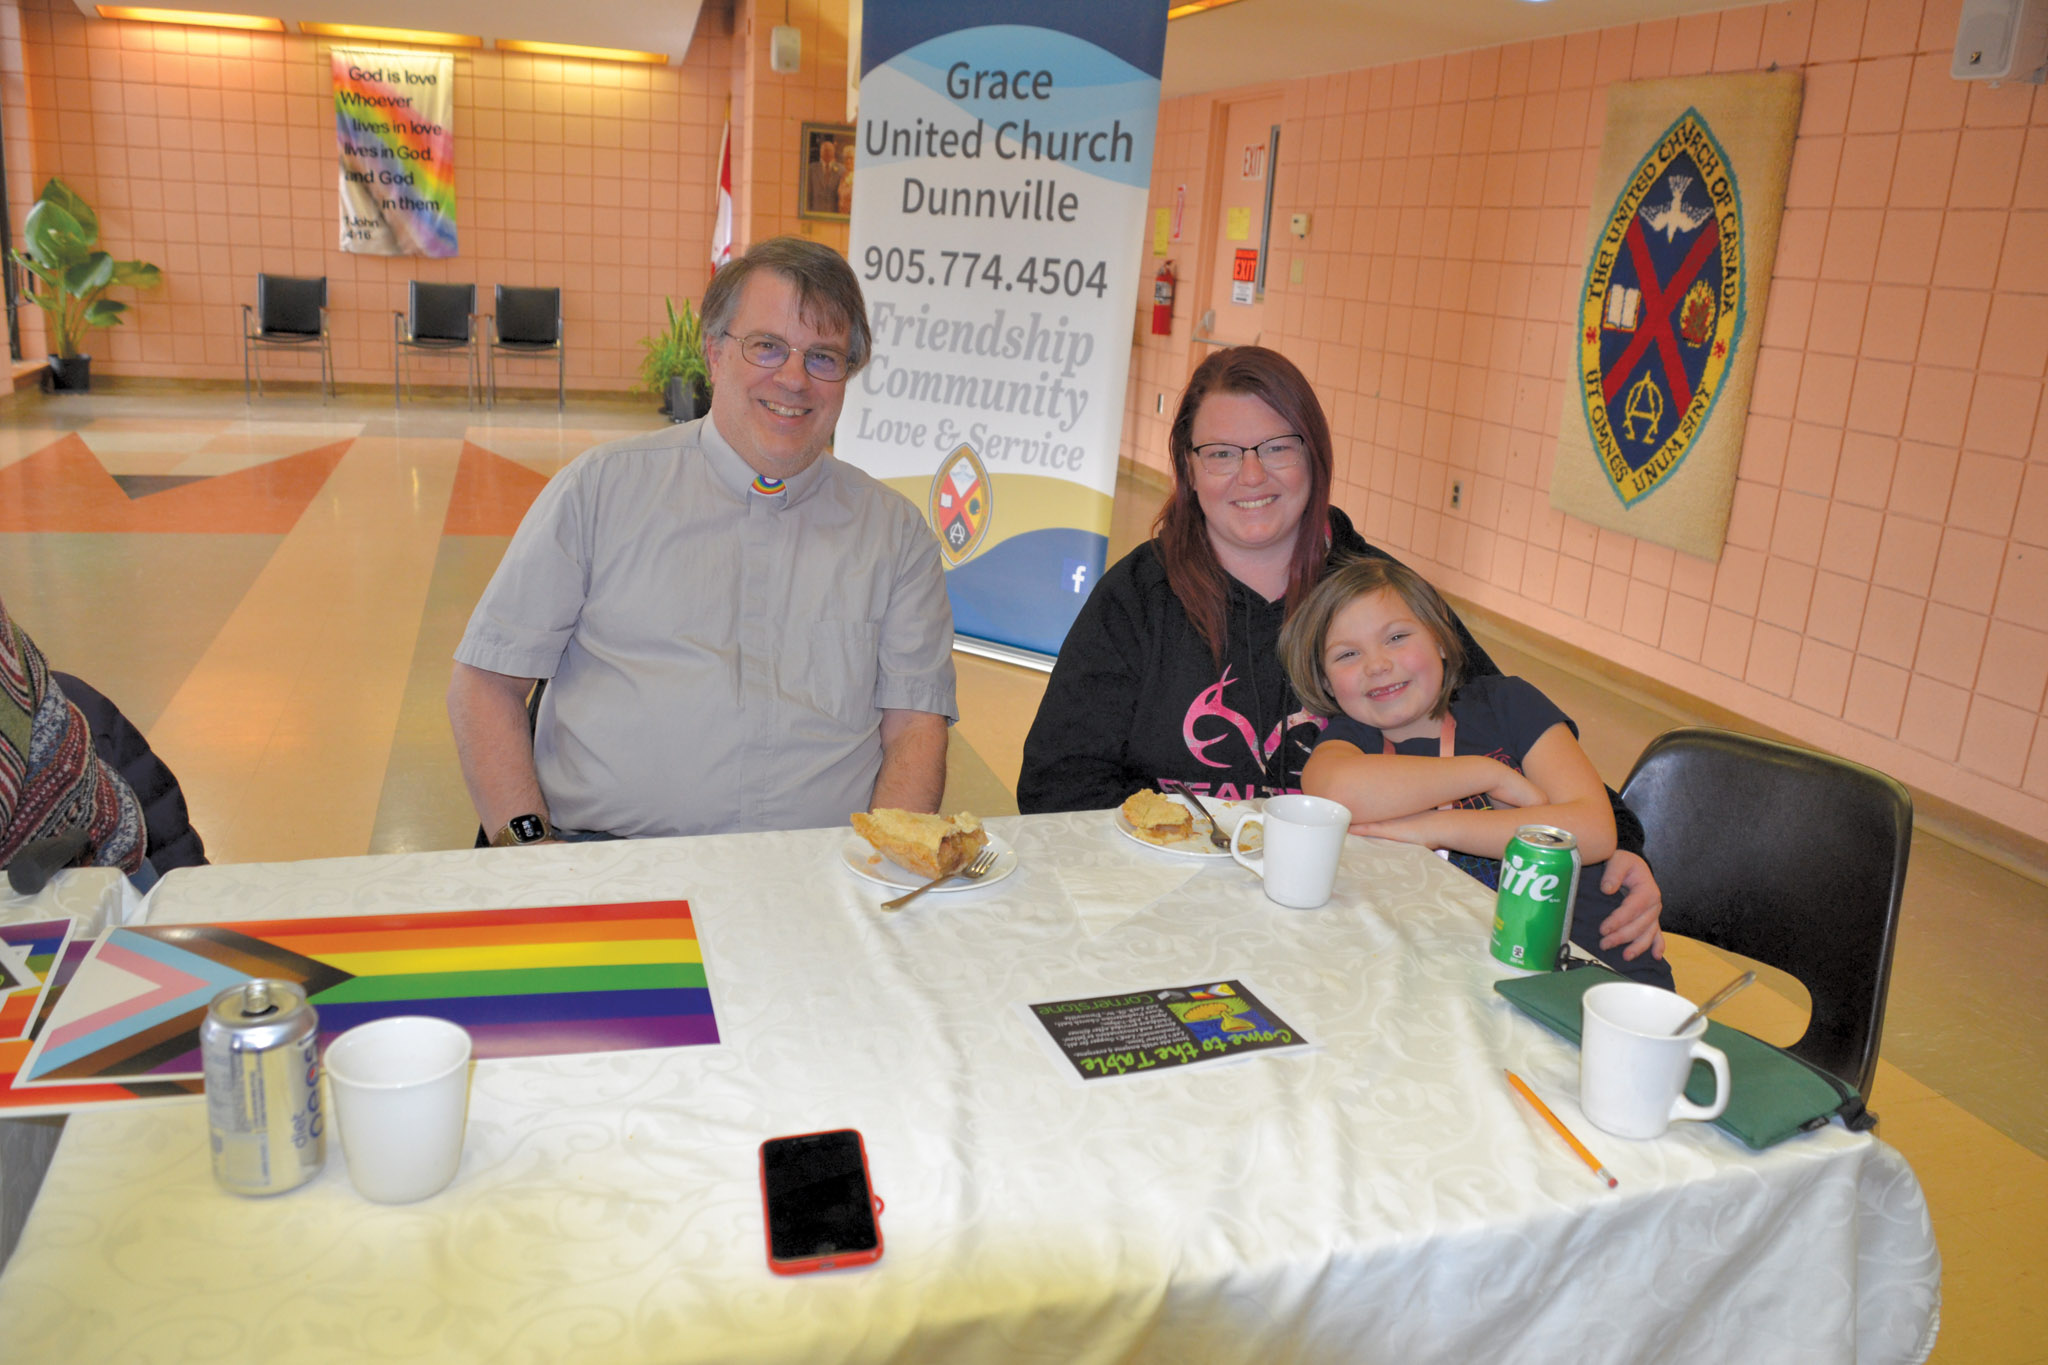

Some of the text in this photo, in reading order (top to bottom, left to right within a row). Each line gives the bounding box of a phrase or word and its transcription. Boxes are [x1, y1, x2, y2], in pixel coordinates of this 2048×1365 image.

[349, 66, 437, 85] God is love
[946, 61, 1053, 100] Grace
[340, 91, 413, 108] Whoever
[352, 117, 442, 136] lives in love
[865, 117, 1133, 163] United Church
[344, 143, 434, 161] lives in God.
[1243, 144, 1265, 176] EXIT
[345, 170, 414, 186] and God
[1711, 177, 1733, 207] OF
[382, 197, 440, 212] in them
[902, 177, 1079, 222] Dunnville
[1606, 163, 1656, 243] UNITED
[350, 215, 379, 228] John
[863, 246, 1108, 299] 905.774.4504
[1233, 259, 1256, 281] EXIT
[1589, 250, 1613, 302] THE
[1720, 211, 1737, 317] CANADA
[870, 301, 1095, 378] Friendship
[861, 354, 1089, 433] Community
[856, 407, 1085, 472] Love & Service
[1585, 368, 1712, 493] UT OMNES UNUM SINT
[1039, 993, 1154, 1015] Cornerstone
[1080, 1028, 1292, 1075] Come to the Table
